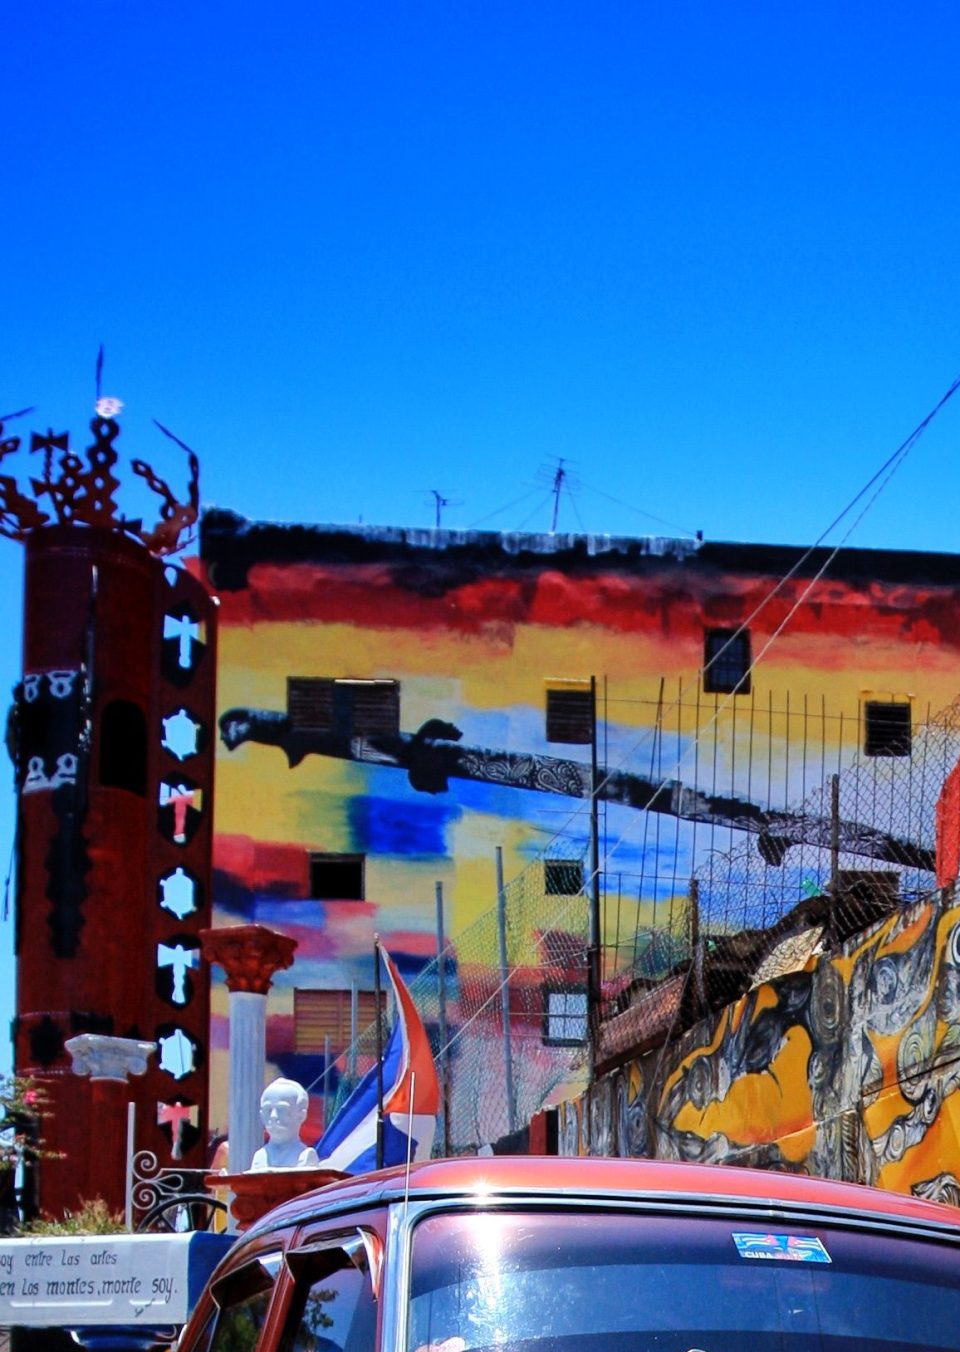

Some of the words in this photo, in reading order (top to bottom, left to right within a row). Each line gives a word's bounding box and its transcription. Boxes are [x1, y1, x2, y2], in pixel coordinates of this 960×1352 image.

[25, 1251, 53, 1266] entre
[90, 1250, 118, 1266] artes
[744, 1250, 773, 1259] CUBA
[102, 1276, 142, 1295] monte
